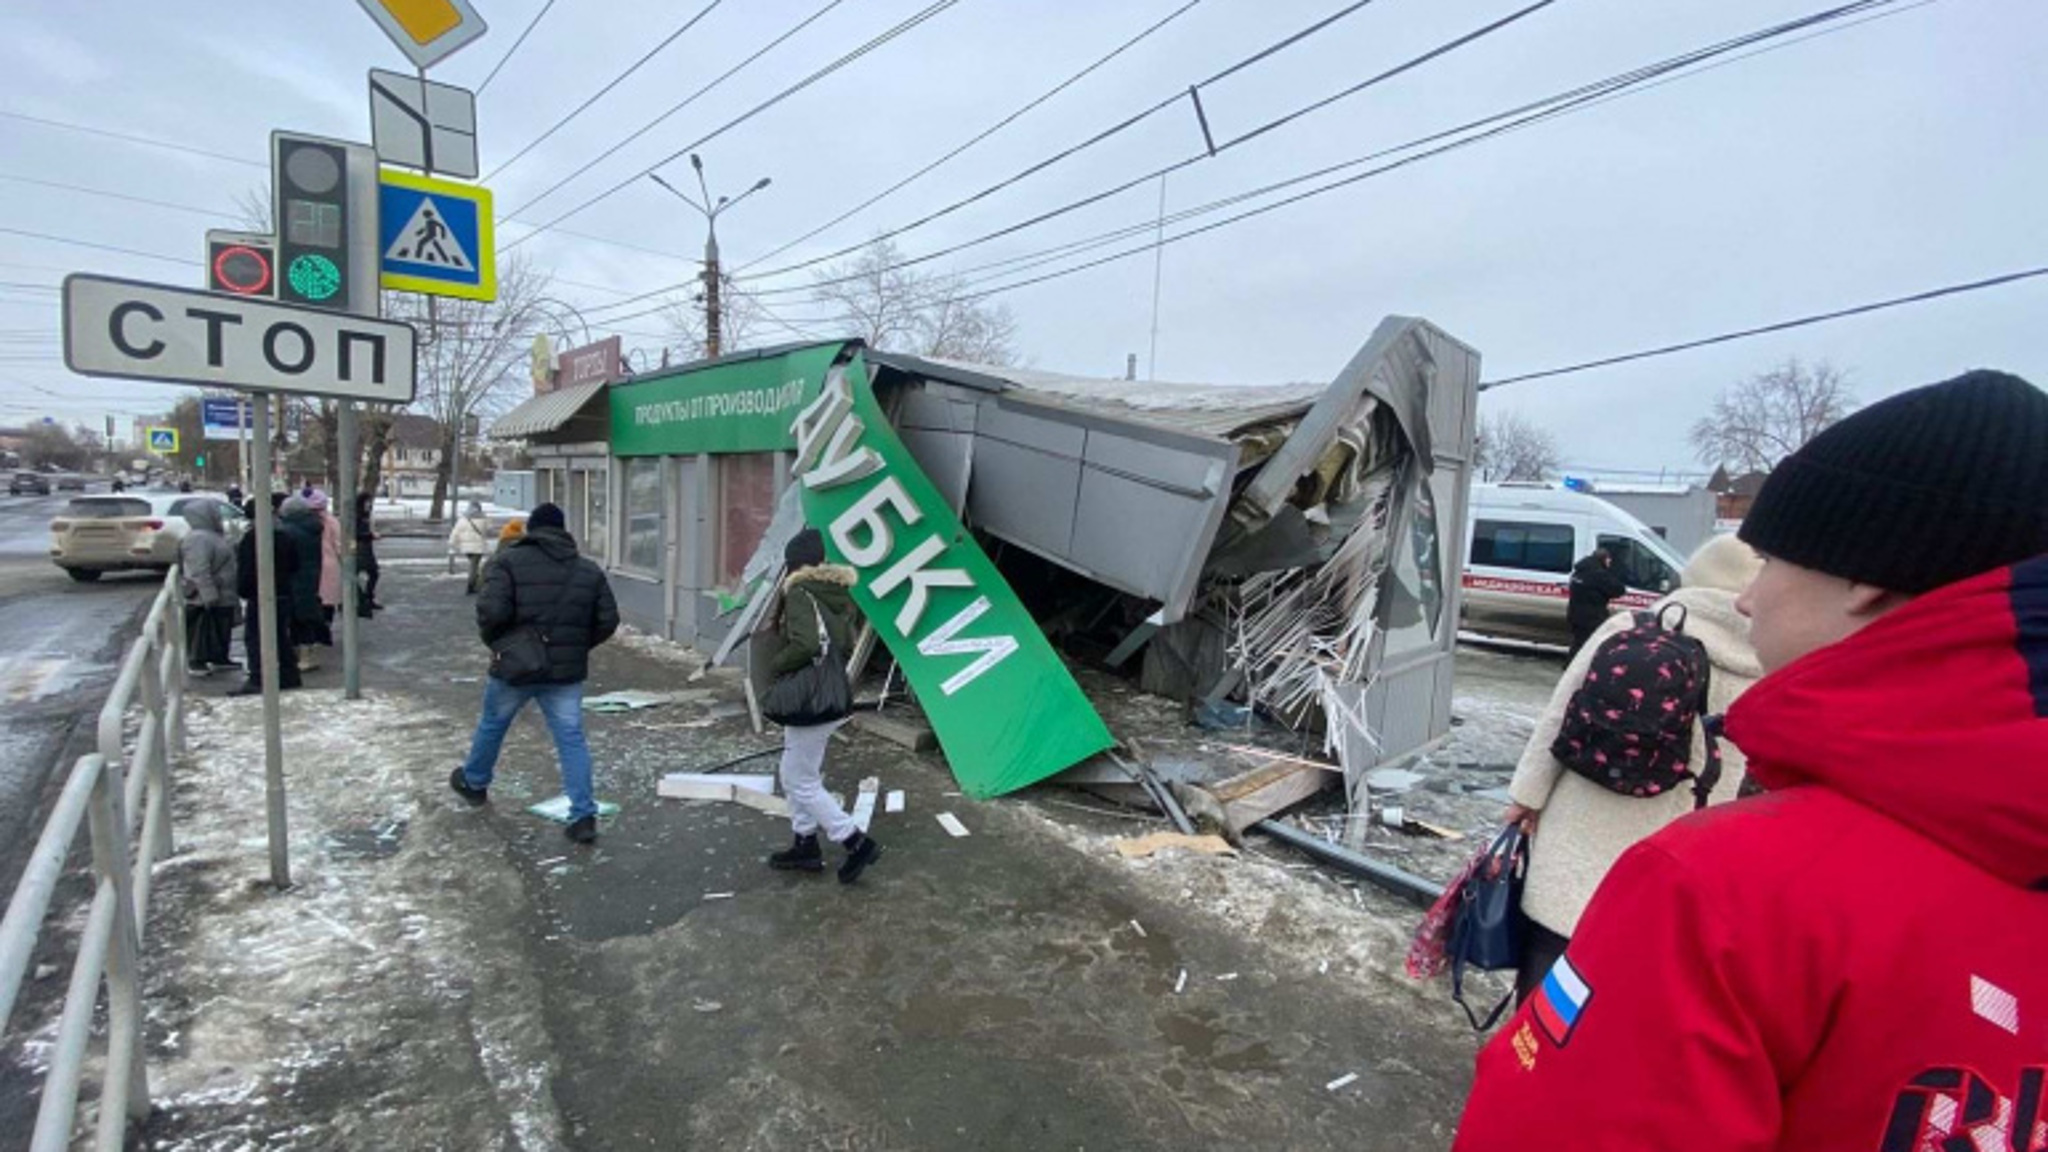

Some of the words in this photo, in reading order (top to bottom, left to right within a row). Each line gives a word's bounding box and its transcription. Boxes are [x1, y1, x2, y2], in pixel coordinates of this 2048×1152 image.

[108, 301, 387, 385] СТОП
[635, 399, 690, 426] ПРОДУКТЫ
[691, 396, 703, 420] ОТ
[789, 371, 1020, 696] ДУБКИ
